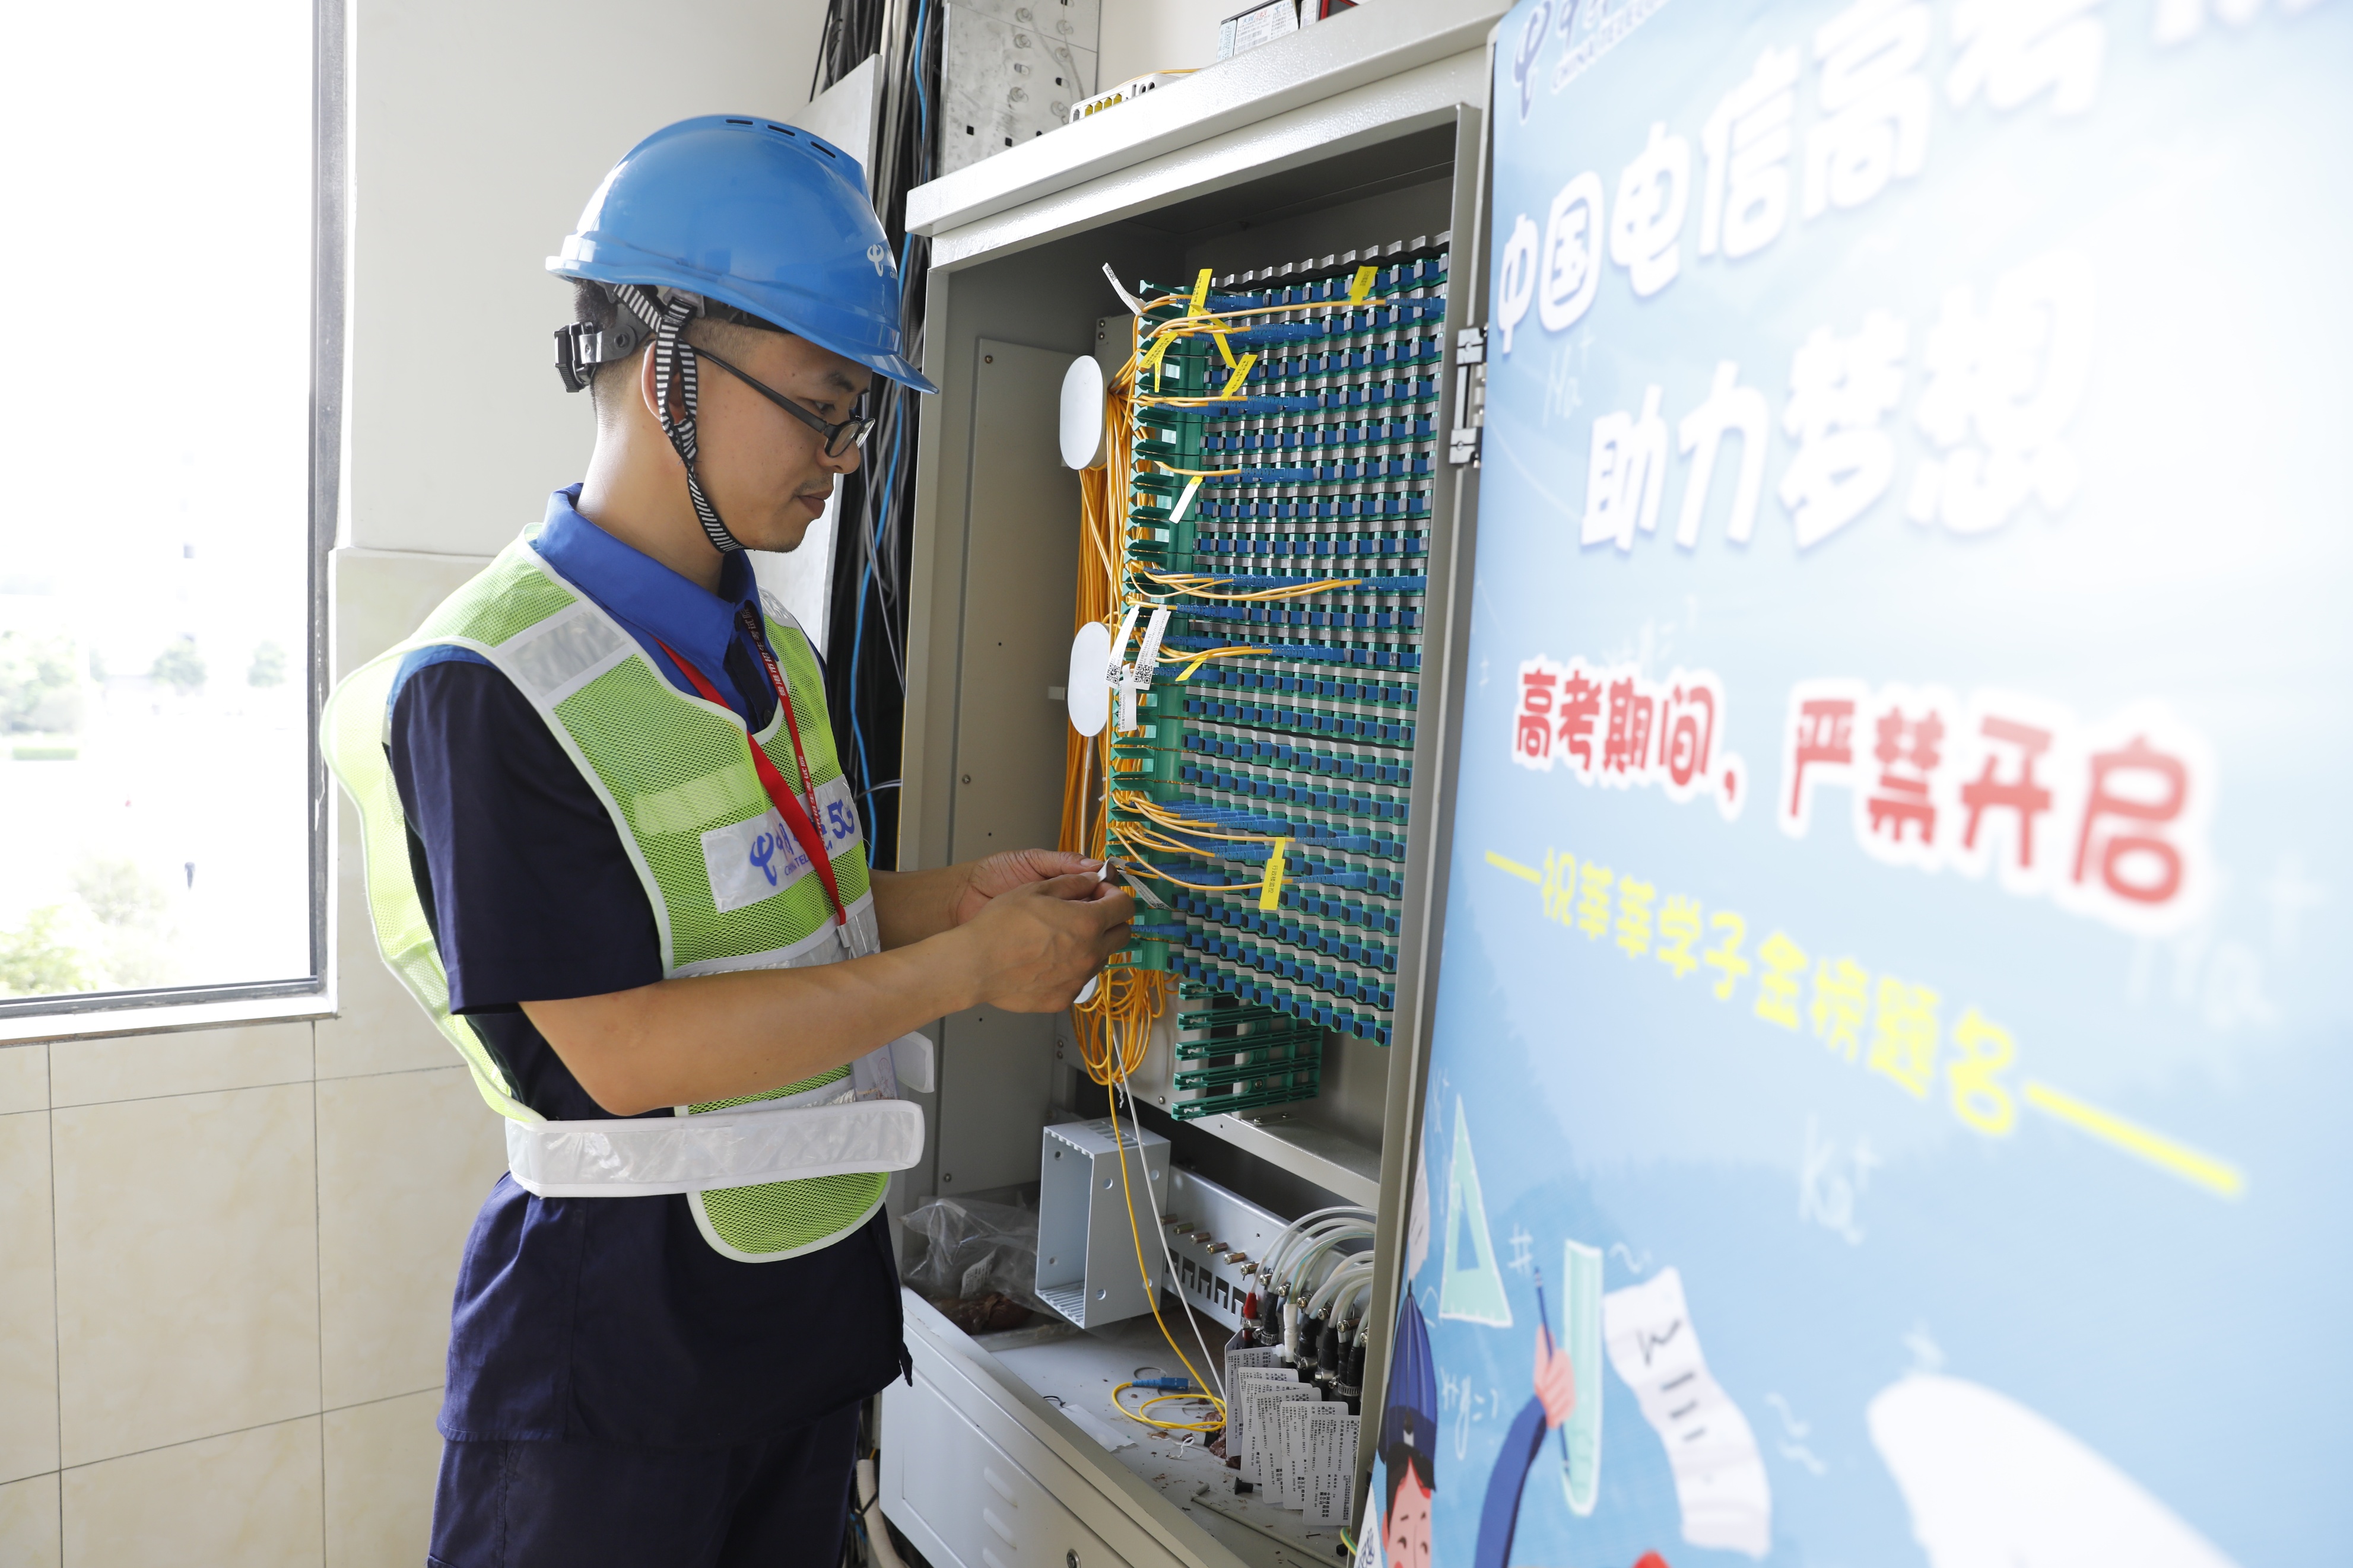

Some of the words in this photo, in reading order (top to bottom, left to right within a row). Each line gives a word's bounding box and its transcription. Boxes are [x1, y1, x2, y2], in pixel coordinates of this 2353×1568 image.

[1581, 246, 2098, 555] 助力梦想
[827, 799, 855, 839] 5G
[1268, 866, 1278, 893] 行政楼监控
